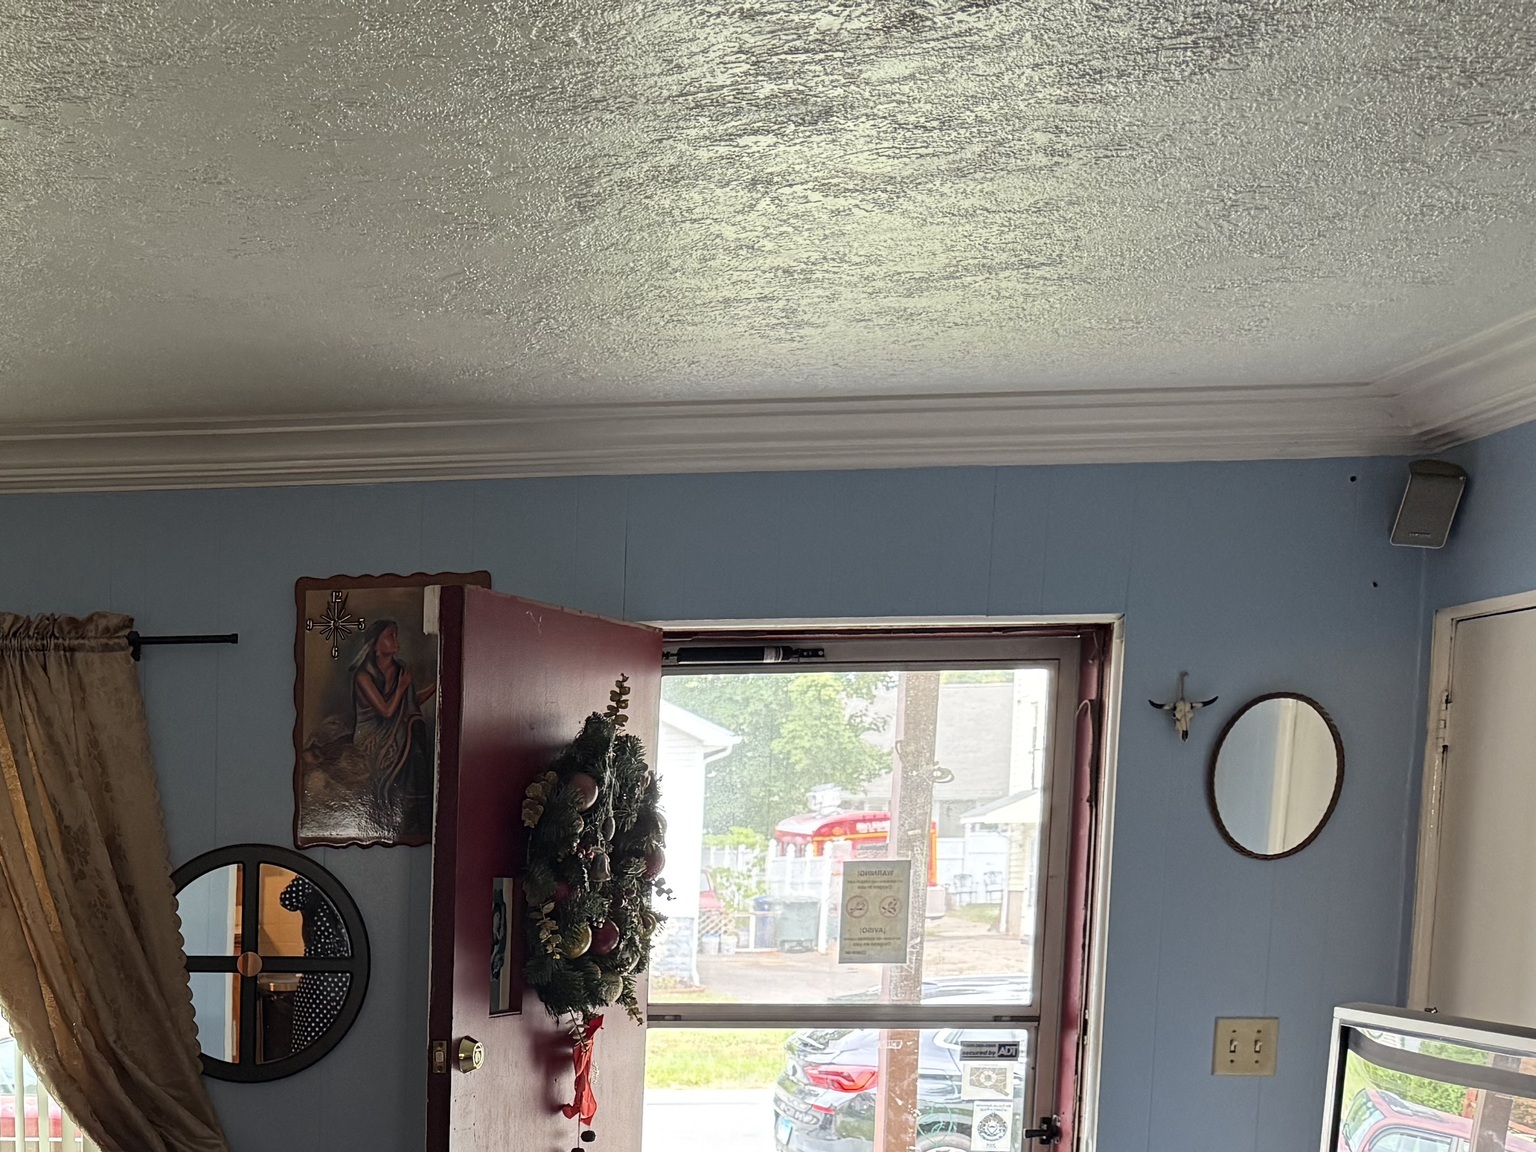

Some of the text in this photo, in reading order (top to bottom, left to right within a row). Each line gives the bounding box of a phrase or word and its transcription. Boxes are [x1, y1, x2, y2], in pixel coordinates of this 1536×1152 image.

[332, 591, 342, 602] 12
[306, 619, 313, 631] 9
[332, 647, 339, 658] 6
[998, 1046, 1018, 1056] ADT
